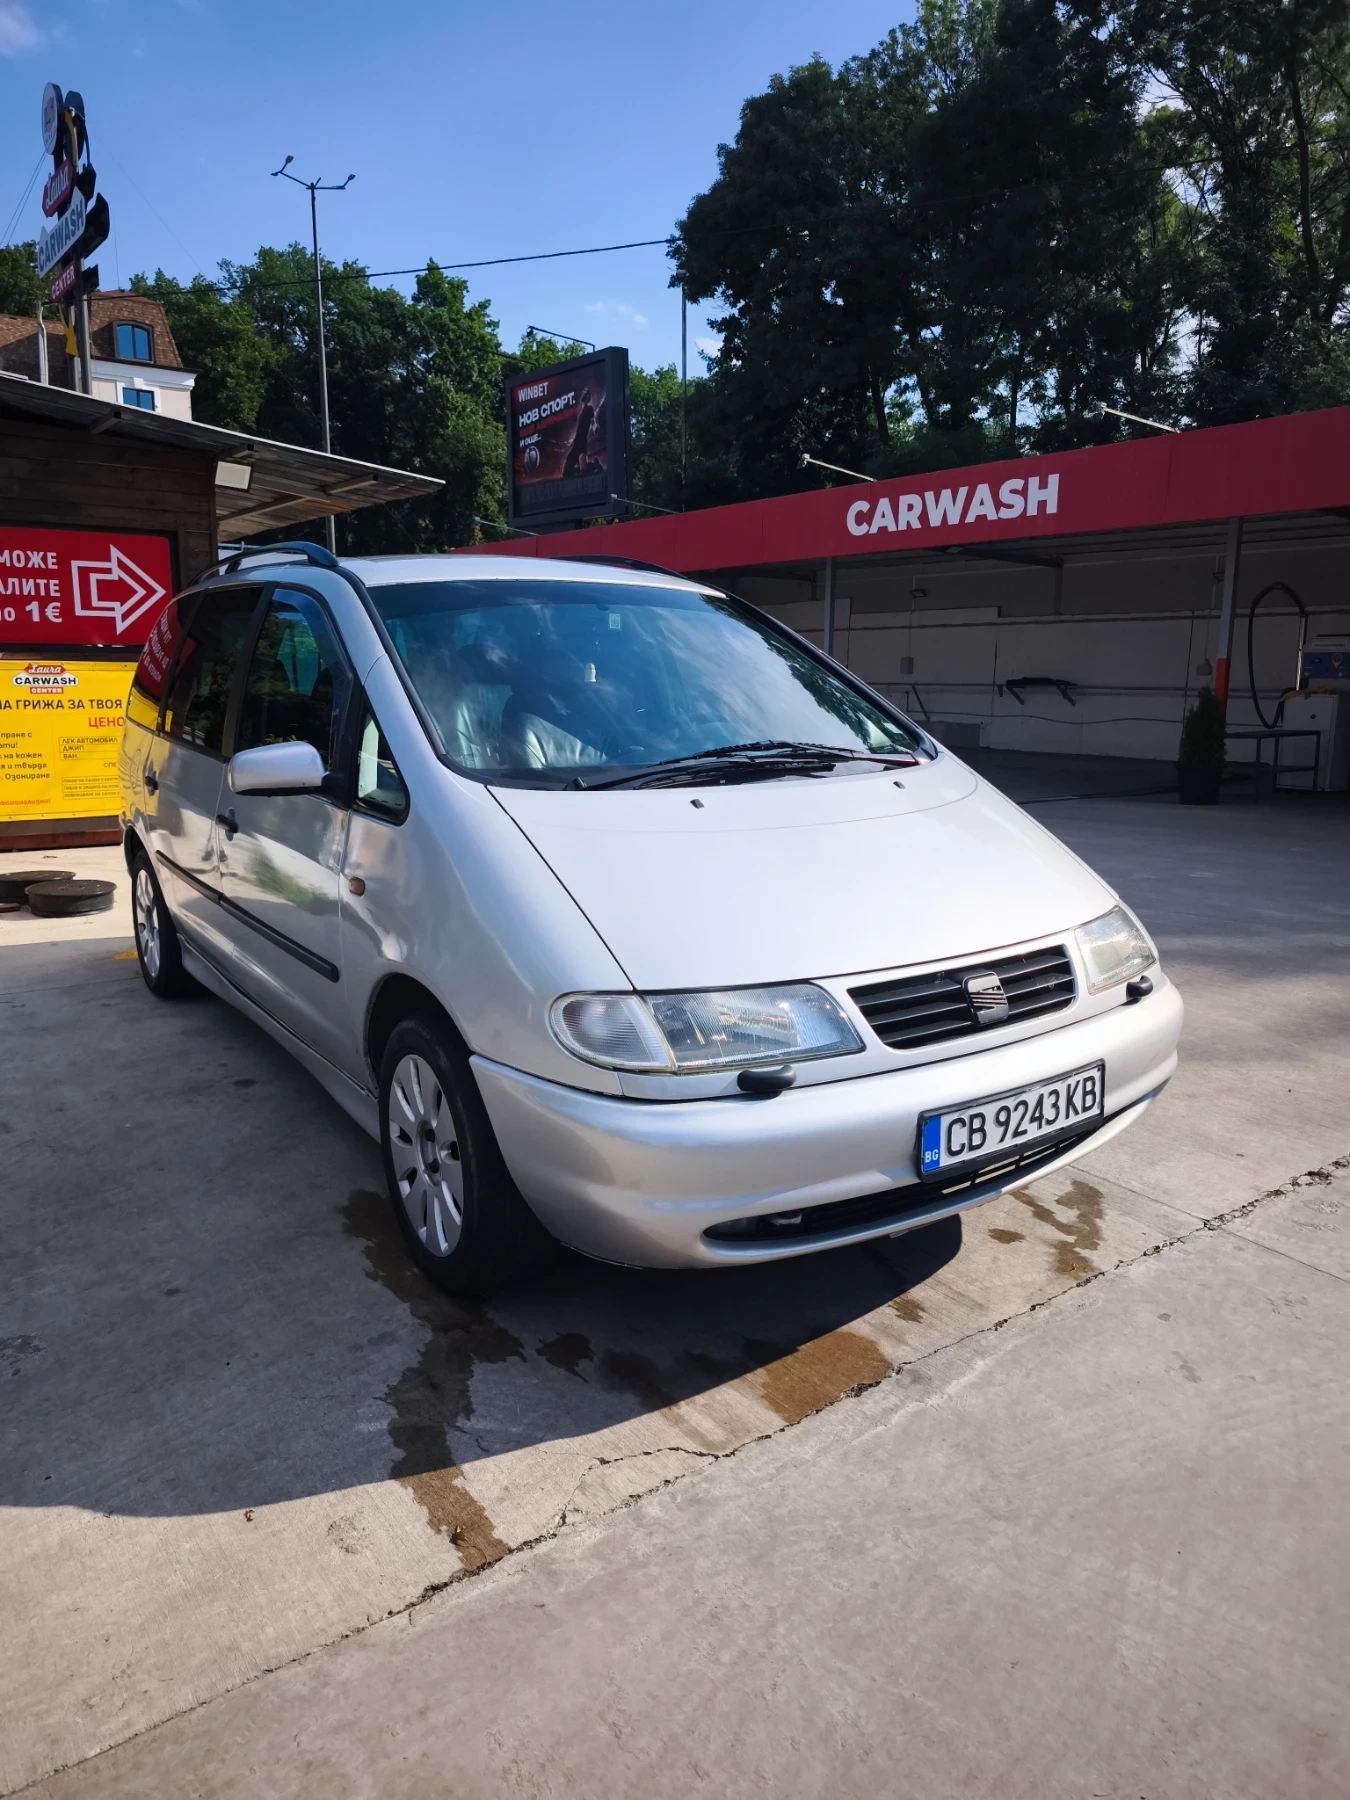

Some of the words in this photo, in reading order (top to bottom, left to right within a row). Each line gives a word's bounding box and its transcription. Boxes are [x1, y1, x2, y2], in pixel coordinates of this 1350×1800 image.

[38, 198, 84, 272] CARWASH
[51, 264, 75, 299] CENTER
[518, 382, 548, 402] WINBET
[519, 408, 540, 427] НОВ
[540, 391, 576, 417] СПОРТ.
[846, 473, 1060, 537] CARWASH
[0, 549, 58, 569] МОЖЕ
[0, 607, 15, 622] о
[25, 601, 63, 623] 1€
[28, 664, 62, 674] Laura
[15, 677, 77, 685] CARWASH
[16, 699, 65, 710] ГРИЖА
[68, 699, 85, 709] ЗА
[88, 699, 123, 709] ТВОЯ
[0, 732, 26, 740] пране
[5, 772, 51, 781] Озониране
[946, 1111, 988, 1157] CB
[993, 1088, 1061, 1145] 9243
[1064, 1075, 1098, 1121] KB
[924, 1149, 939, 1164] BG
